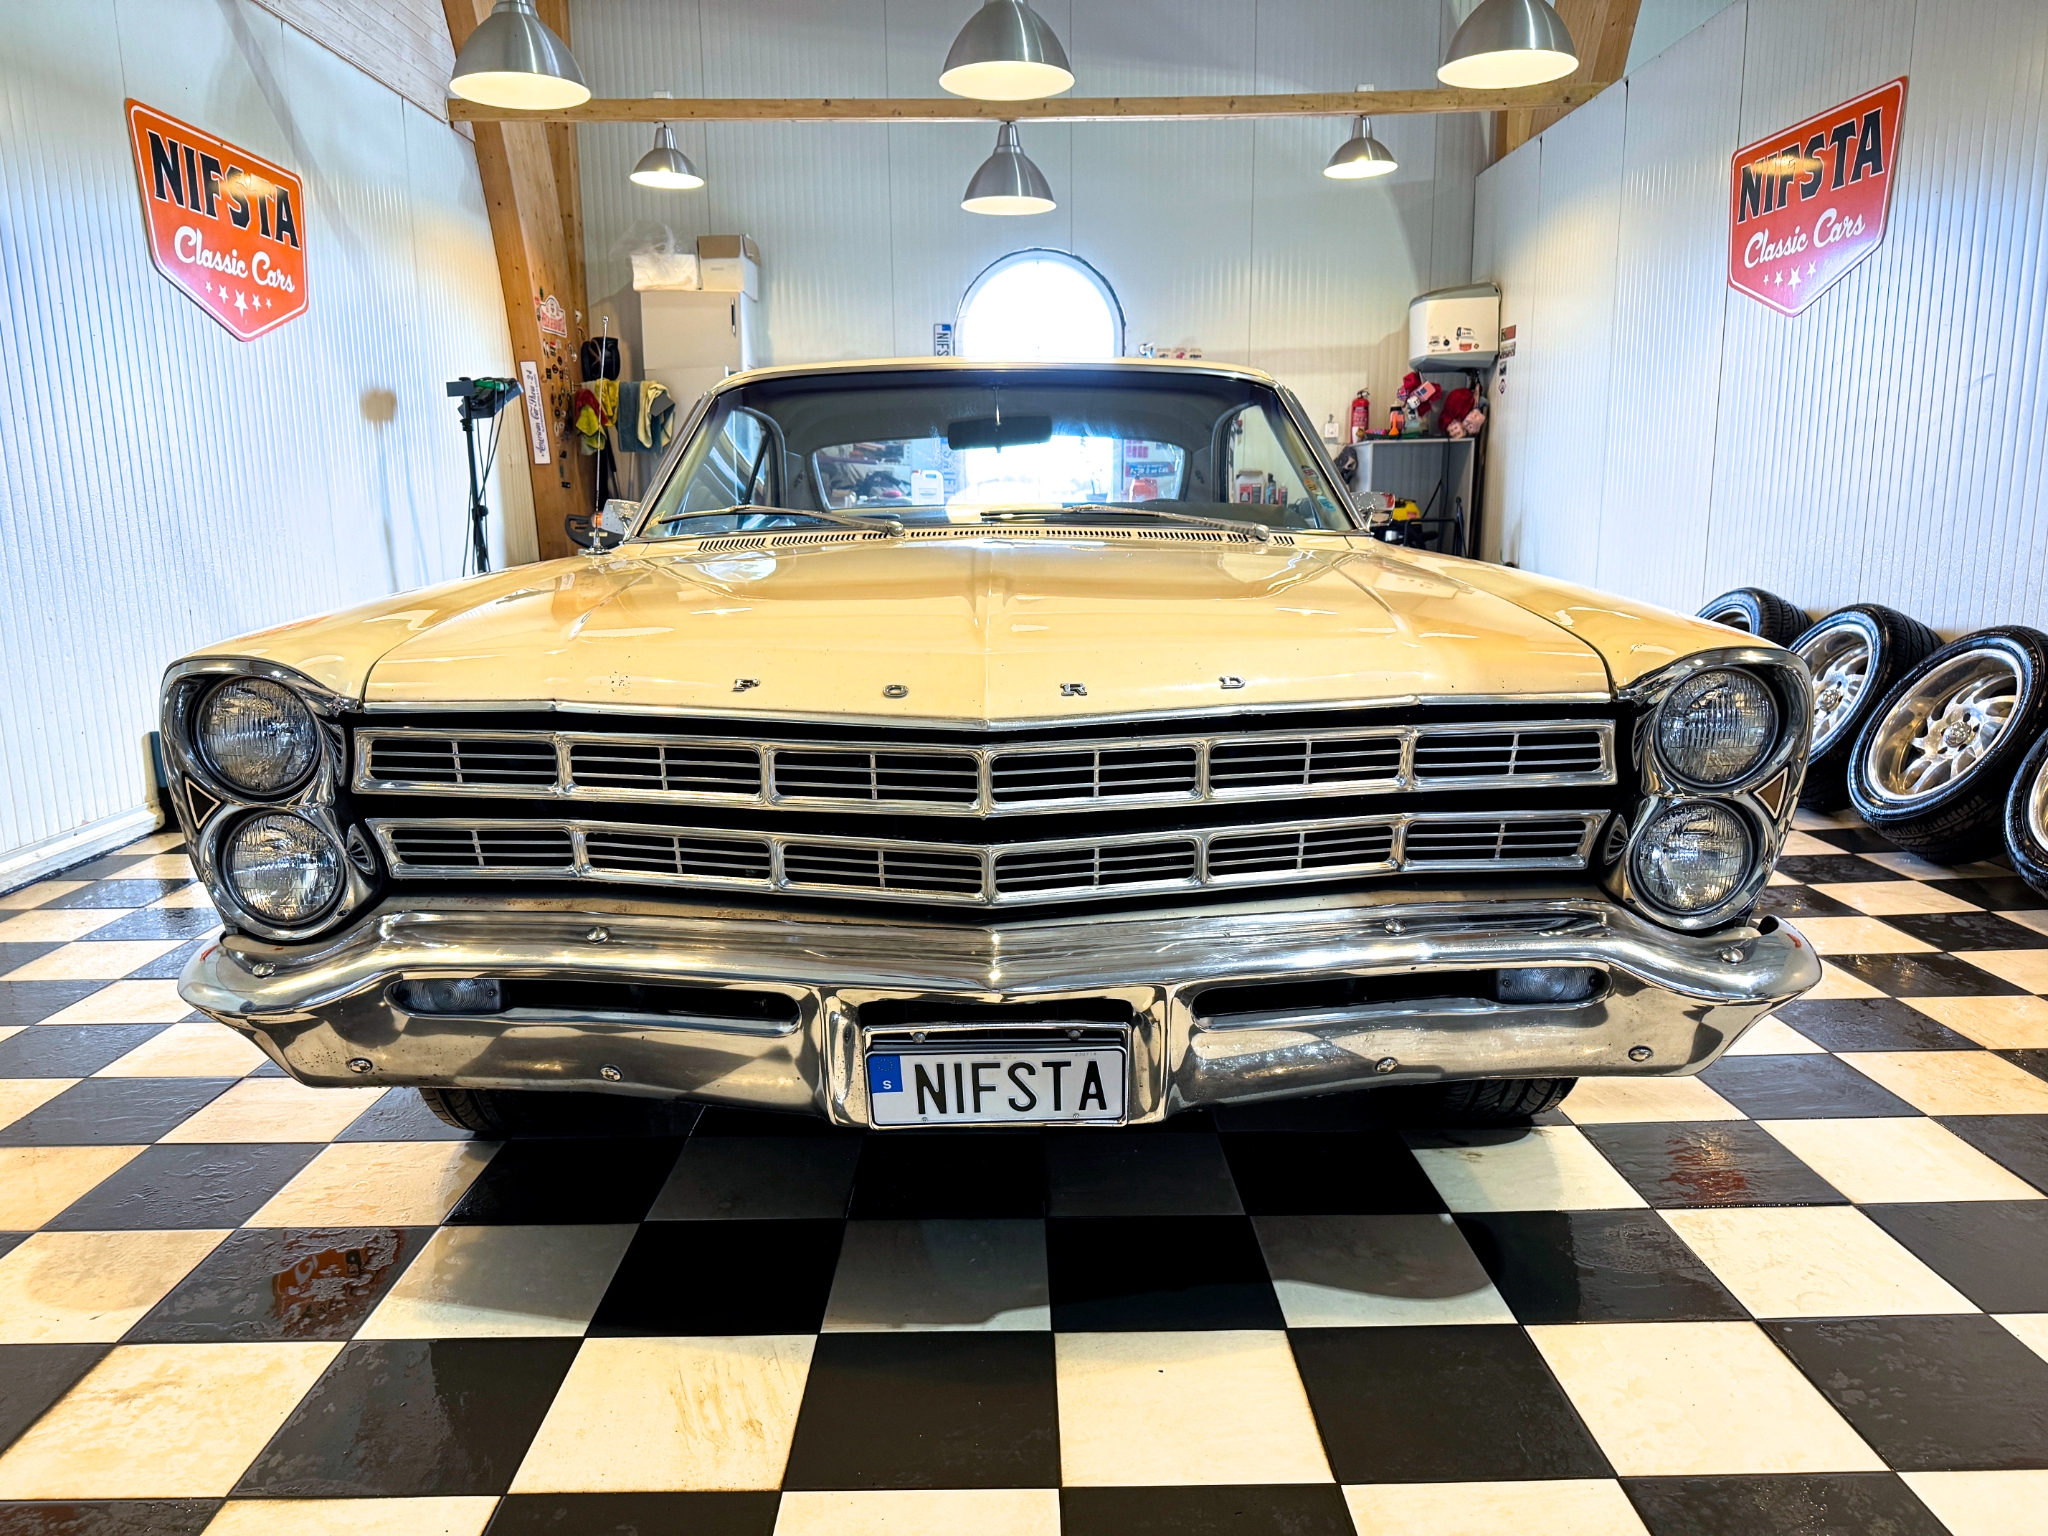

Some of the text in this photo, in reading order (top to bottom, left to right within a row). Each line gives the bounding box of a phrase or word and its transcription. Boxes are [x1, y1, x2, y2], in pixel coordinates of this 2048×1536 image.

[146, 127, 301, 250] NIFSTA
[1736, 105, 1885, 225] NIFSTA
[174, 225, 295, 293] Classic Cars
[1744, 207, 1866, 268] Classic Cars
[731, 676, 1246, 698] FORD
[882, 1080, 892, 1090] S
[914, 1060, 1108, 1115] NIFSTA
